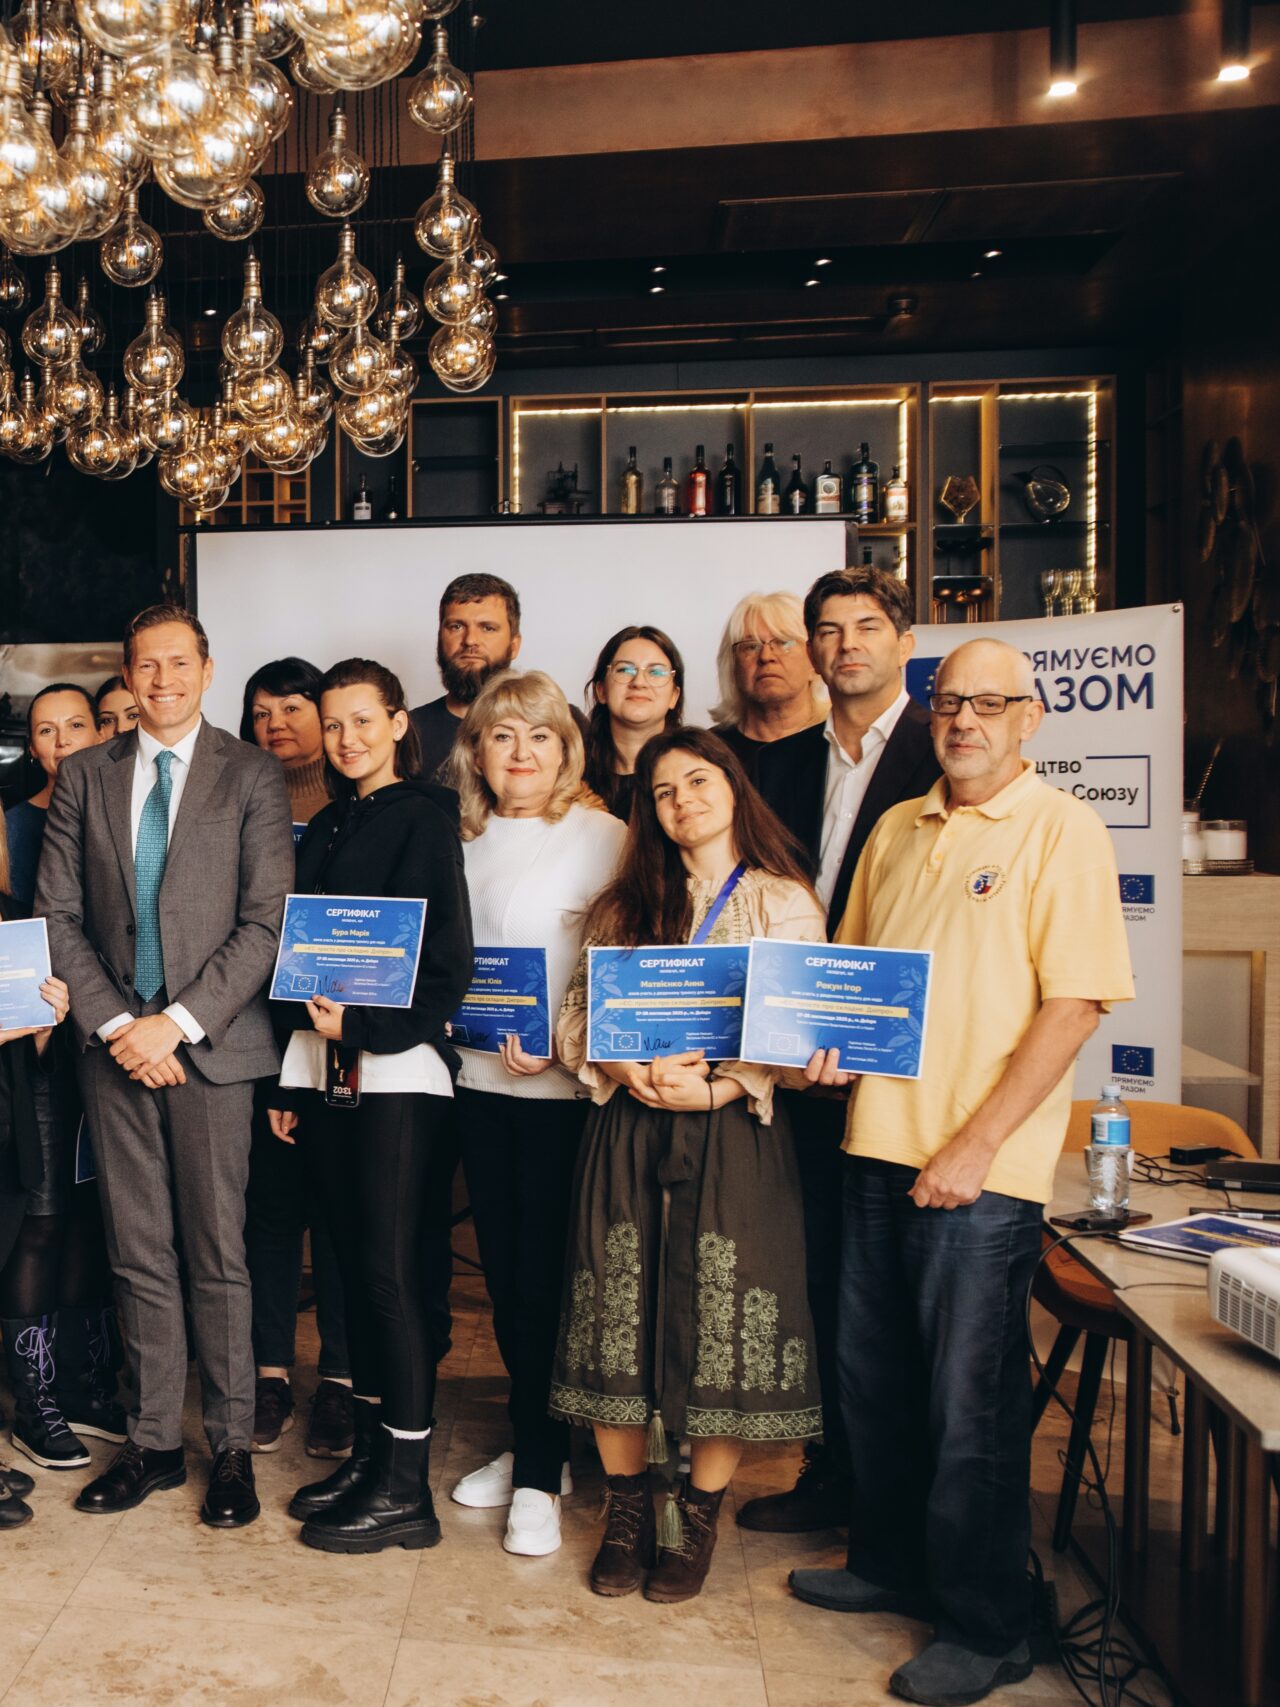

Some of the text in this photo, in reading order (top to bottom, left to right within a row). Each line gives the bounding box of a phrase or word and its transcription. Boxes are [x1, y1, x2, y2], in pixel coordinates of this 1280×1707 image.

[1023, 644, 1156, 672] ЯМУЄМО
[1034, 672, 1154, 713] АЗОМ
[1072, 784, 1138, 806] Союзу
[326, 908, 381, 918] СЕРТИФІКАТ
[350, 929, 369, 937] Марія
[474, 957, 509, 966] РТИФІКАТ
[640, 958, 705, 968] СЕРТИФІКАТ
[804, 956, 876, 971] СЕРТИФІКАТ
[844, 982, 862, 992] Ігор
[1111, 1076, 1155, 1087] ПРЯМУЄМО
